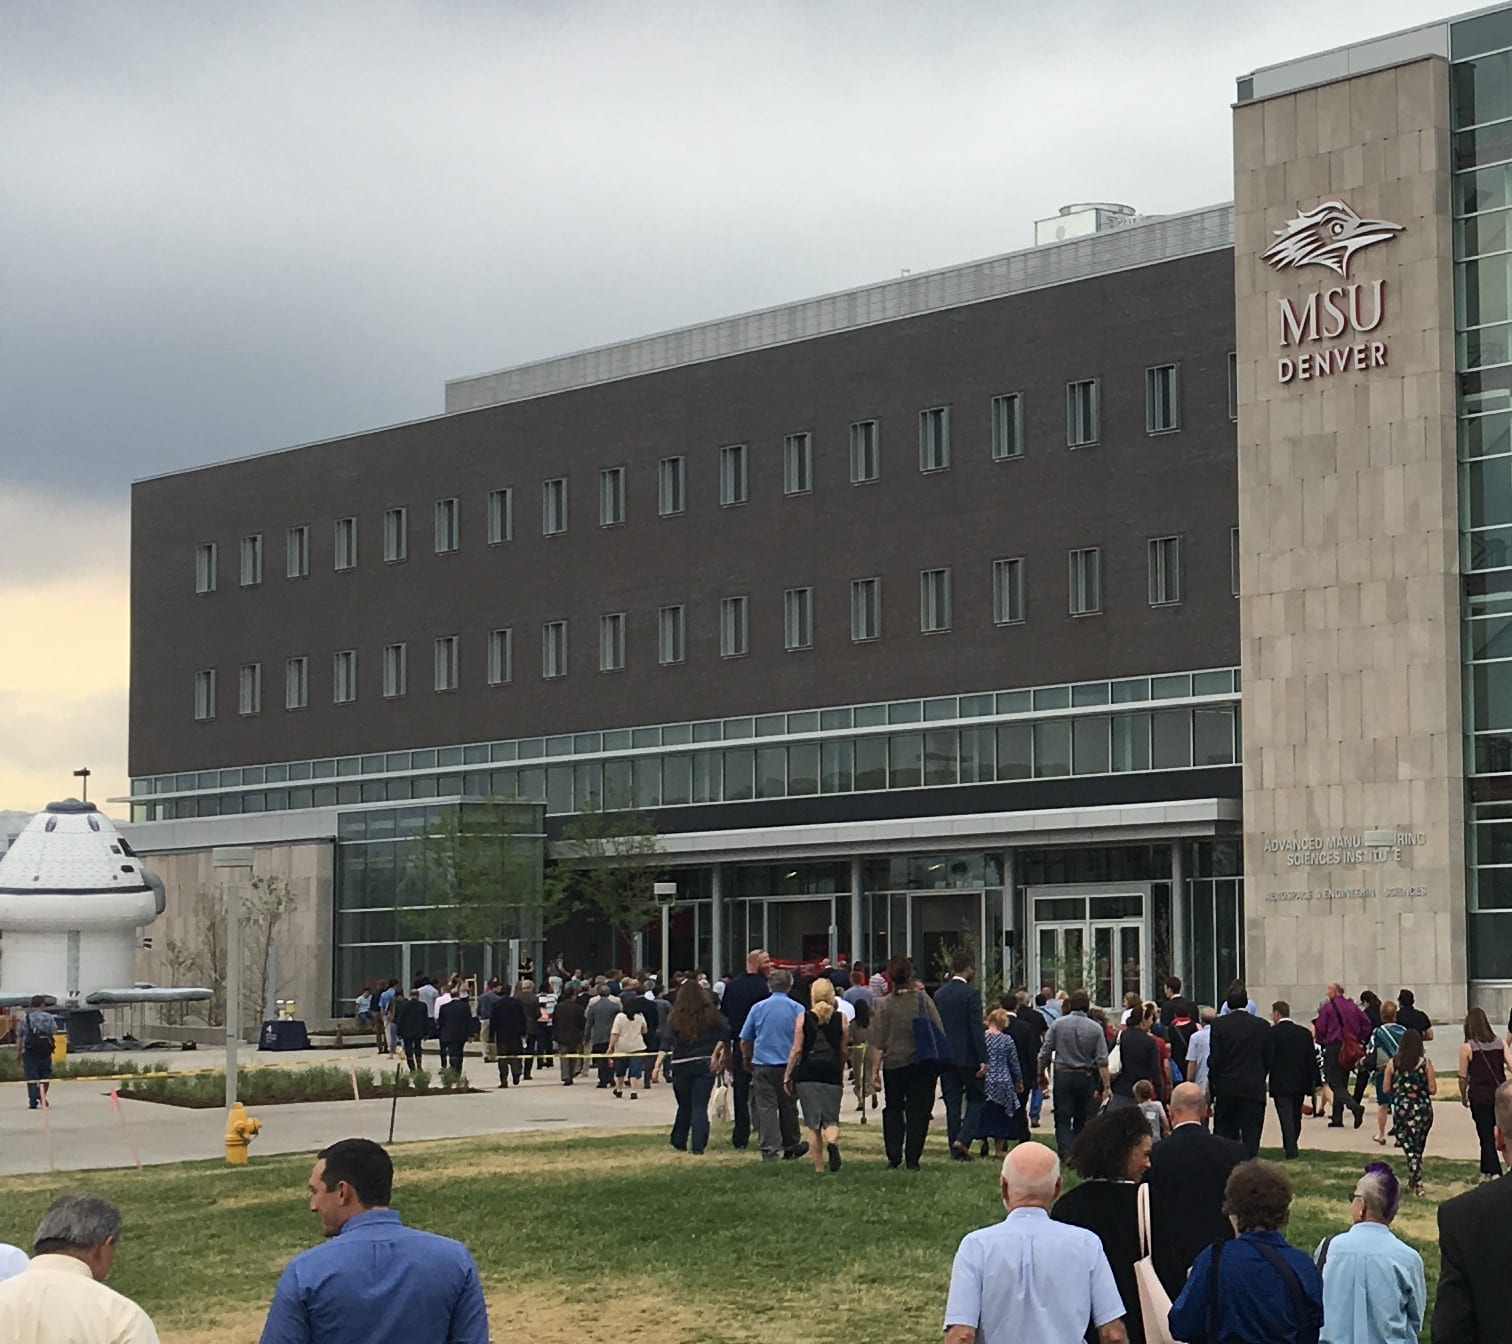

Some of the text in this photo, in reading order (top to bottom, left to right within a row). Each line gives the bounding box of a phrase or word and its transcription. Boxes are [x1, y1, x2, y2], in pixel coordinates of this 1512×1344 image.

[1278, 279, 1387, 347] MSU
[1278, 341, 1388, 383] DENVER
[1264, 832, 1427, 852] ADVANCED MANURING
[1287, 847, 1402, 866] SCIENCES INSITUE
[1323, 888, 1378, 900] ENGINEERIN
